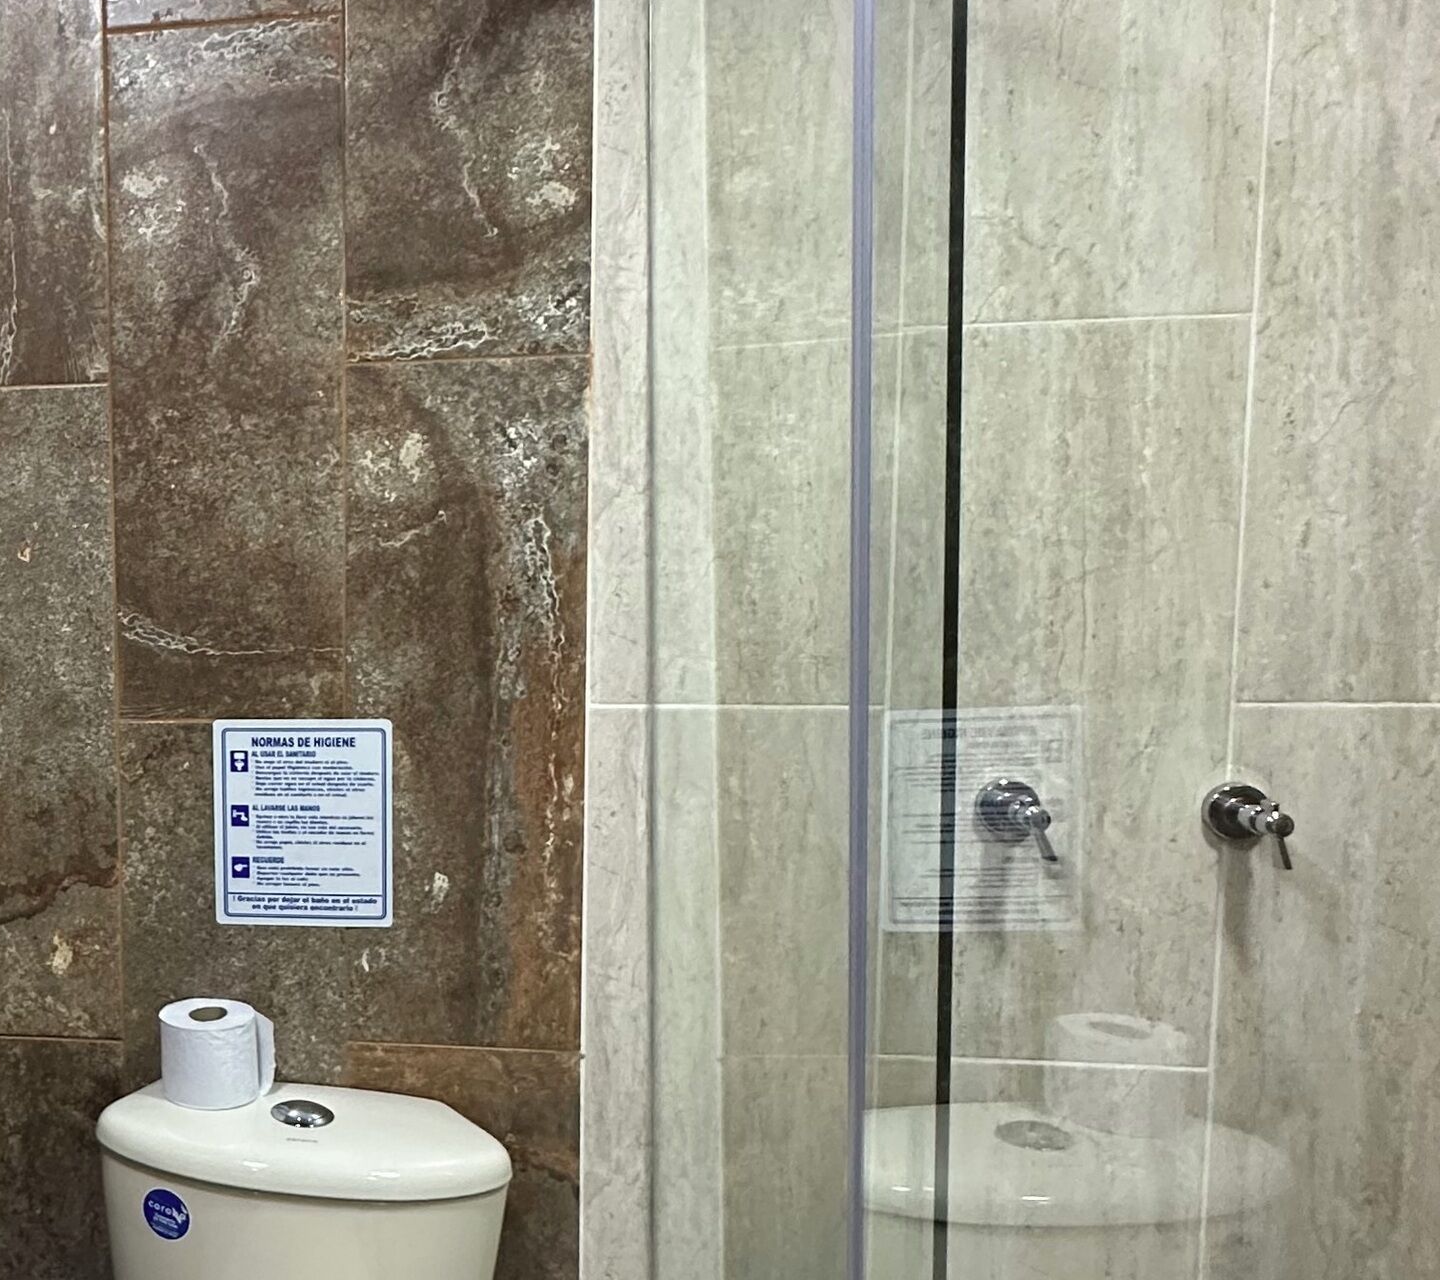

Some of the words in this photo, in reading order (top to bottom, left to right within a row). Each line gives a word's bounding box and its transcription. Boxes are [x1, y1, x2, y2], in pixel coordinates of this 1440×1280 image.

[251, 736, 295, 748] NORMAS
[297, 736, 311, 748] DE
[313, 736, 356, 748] HIGIENE
[285, 750, 316, 758] SANITARIO
[281, 896, 301, 904] dejar
[278, 904, 309, 912] quisiera
